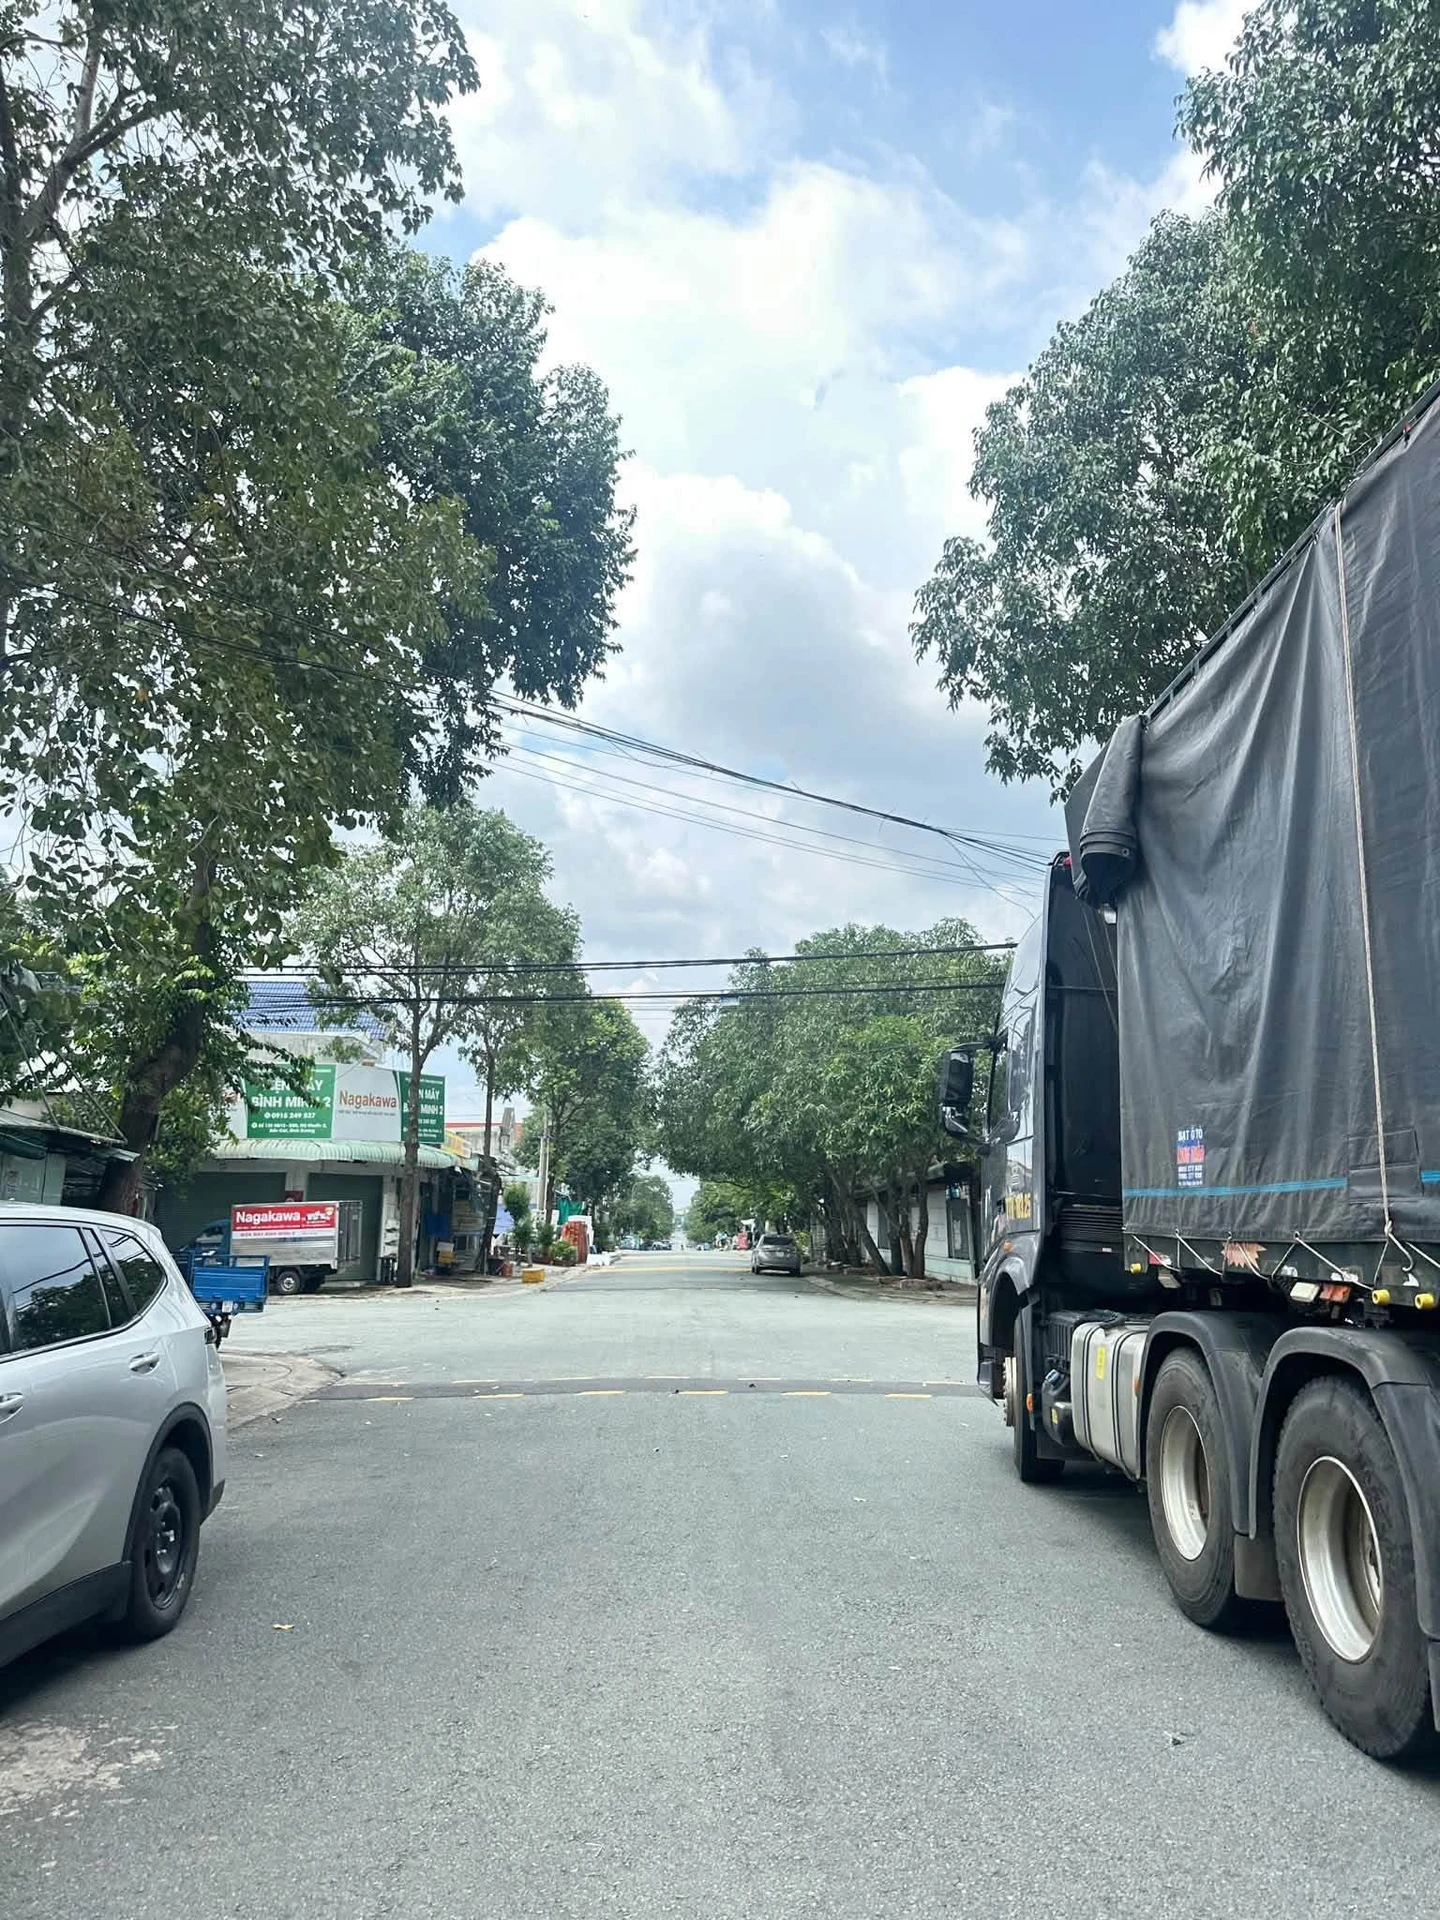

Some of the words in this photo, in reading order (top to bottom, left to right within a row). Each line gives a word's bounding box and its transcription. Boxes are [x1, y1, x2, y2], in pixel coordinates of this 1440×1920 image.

[324, 1096, 331, 1107] 2
[339, 1090, 397, 1109] Nagakawa
[439, 1105, 443, 1115] 2
[236, 1210, 301, 1225] Nagakawa
